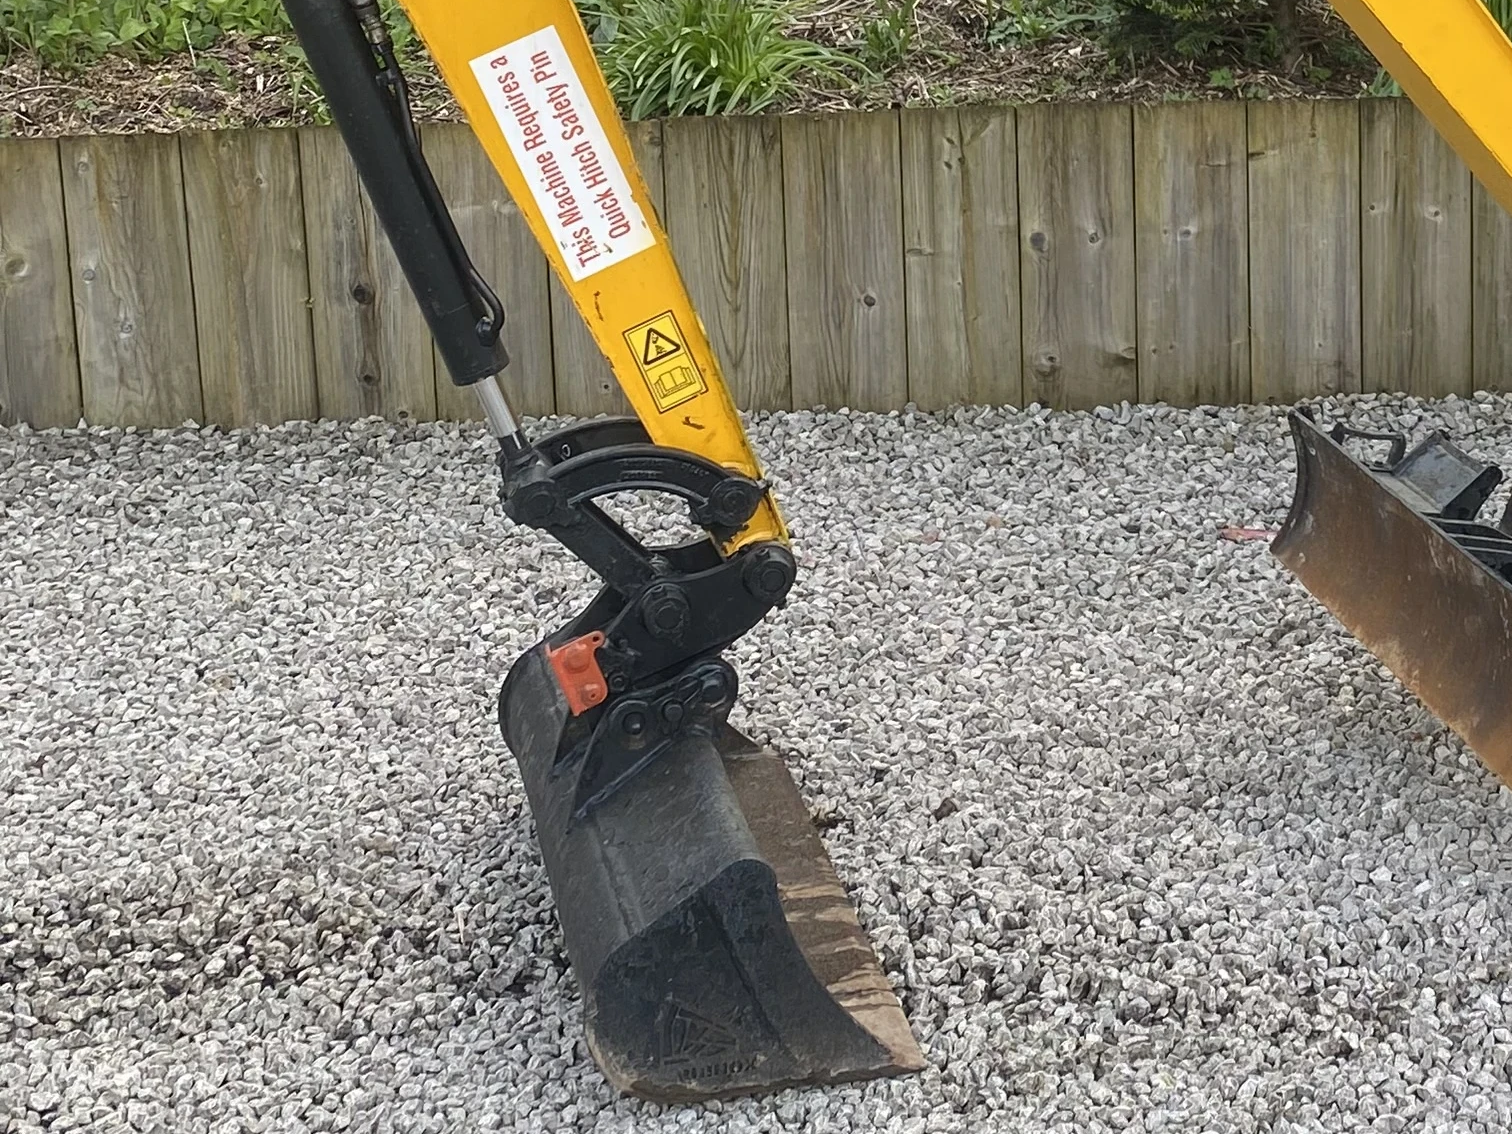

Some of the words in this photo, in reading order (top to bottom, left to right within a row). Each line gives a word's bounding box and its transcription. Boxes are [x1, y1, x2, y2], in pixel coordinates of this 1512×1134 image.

[490, 55, 508, 70] a
[530, 50, 557, 84] Pin
[497, 71, 547, 152] Requires
[545, 83, 585, 141] Safety
[536, 151, 583, 228] Machine
[571, 140, 608, 189] Hitch
[593, 186, 631, 239] Quick
[571, 227, 601, 268] This
